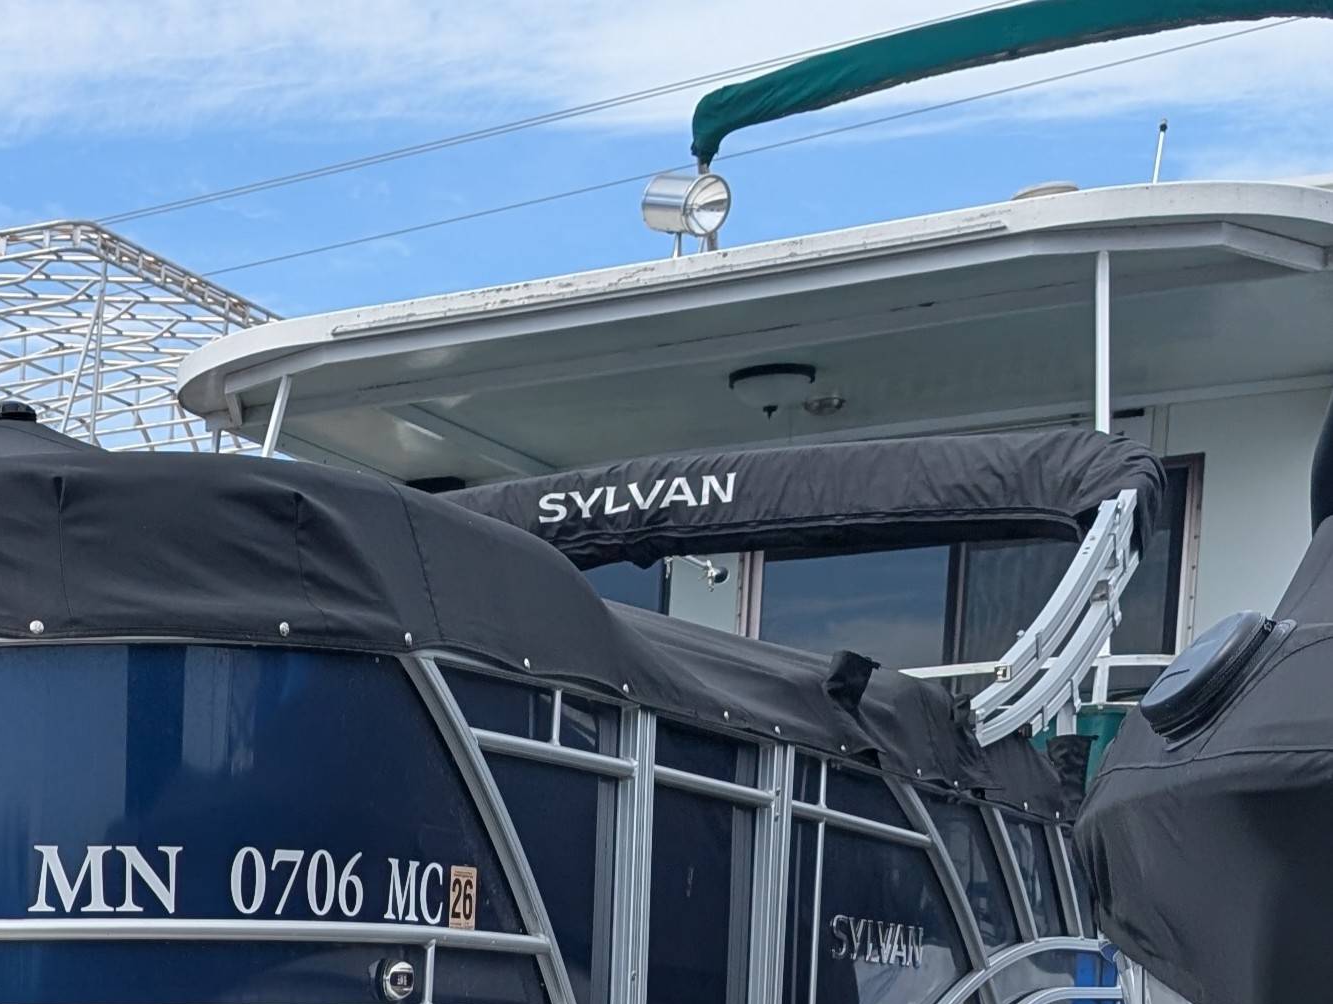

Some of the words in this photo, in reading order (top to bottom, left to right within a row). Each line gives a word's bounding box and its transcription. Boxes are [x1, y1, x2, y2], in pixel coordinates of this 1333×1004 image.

[538, 471, 737, 524] SYLVAN
[27, 845, 184, 914] MN
[230, 846, 364, 918] 0706
[383, 857, 444, 925] MC
[450, 877, 474, 920] 26
[830, 914, 924, 970] SYLVAN
